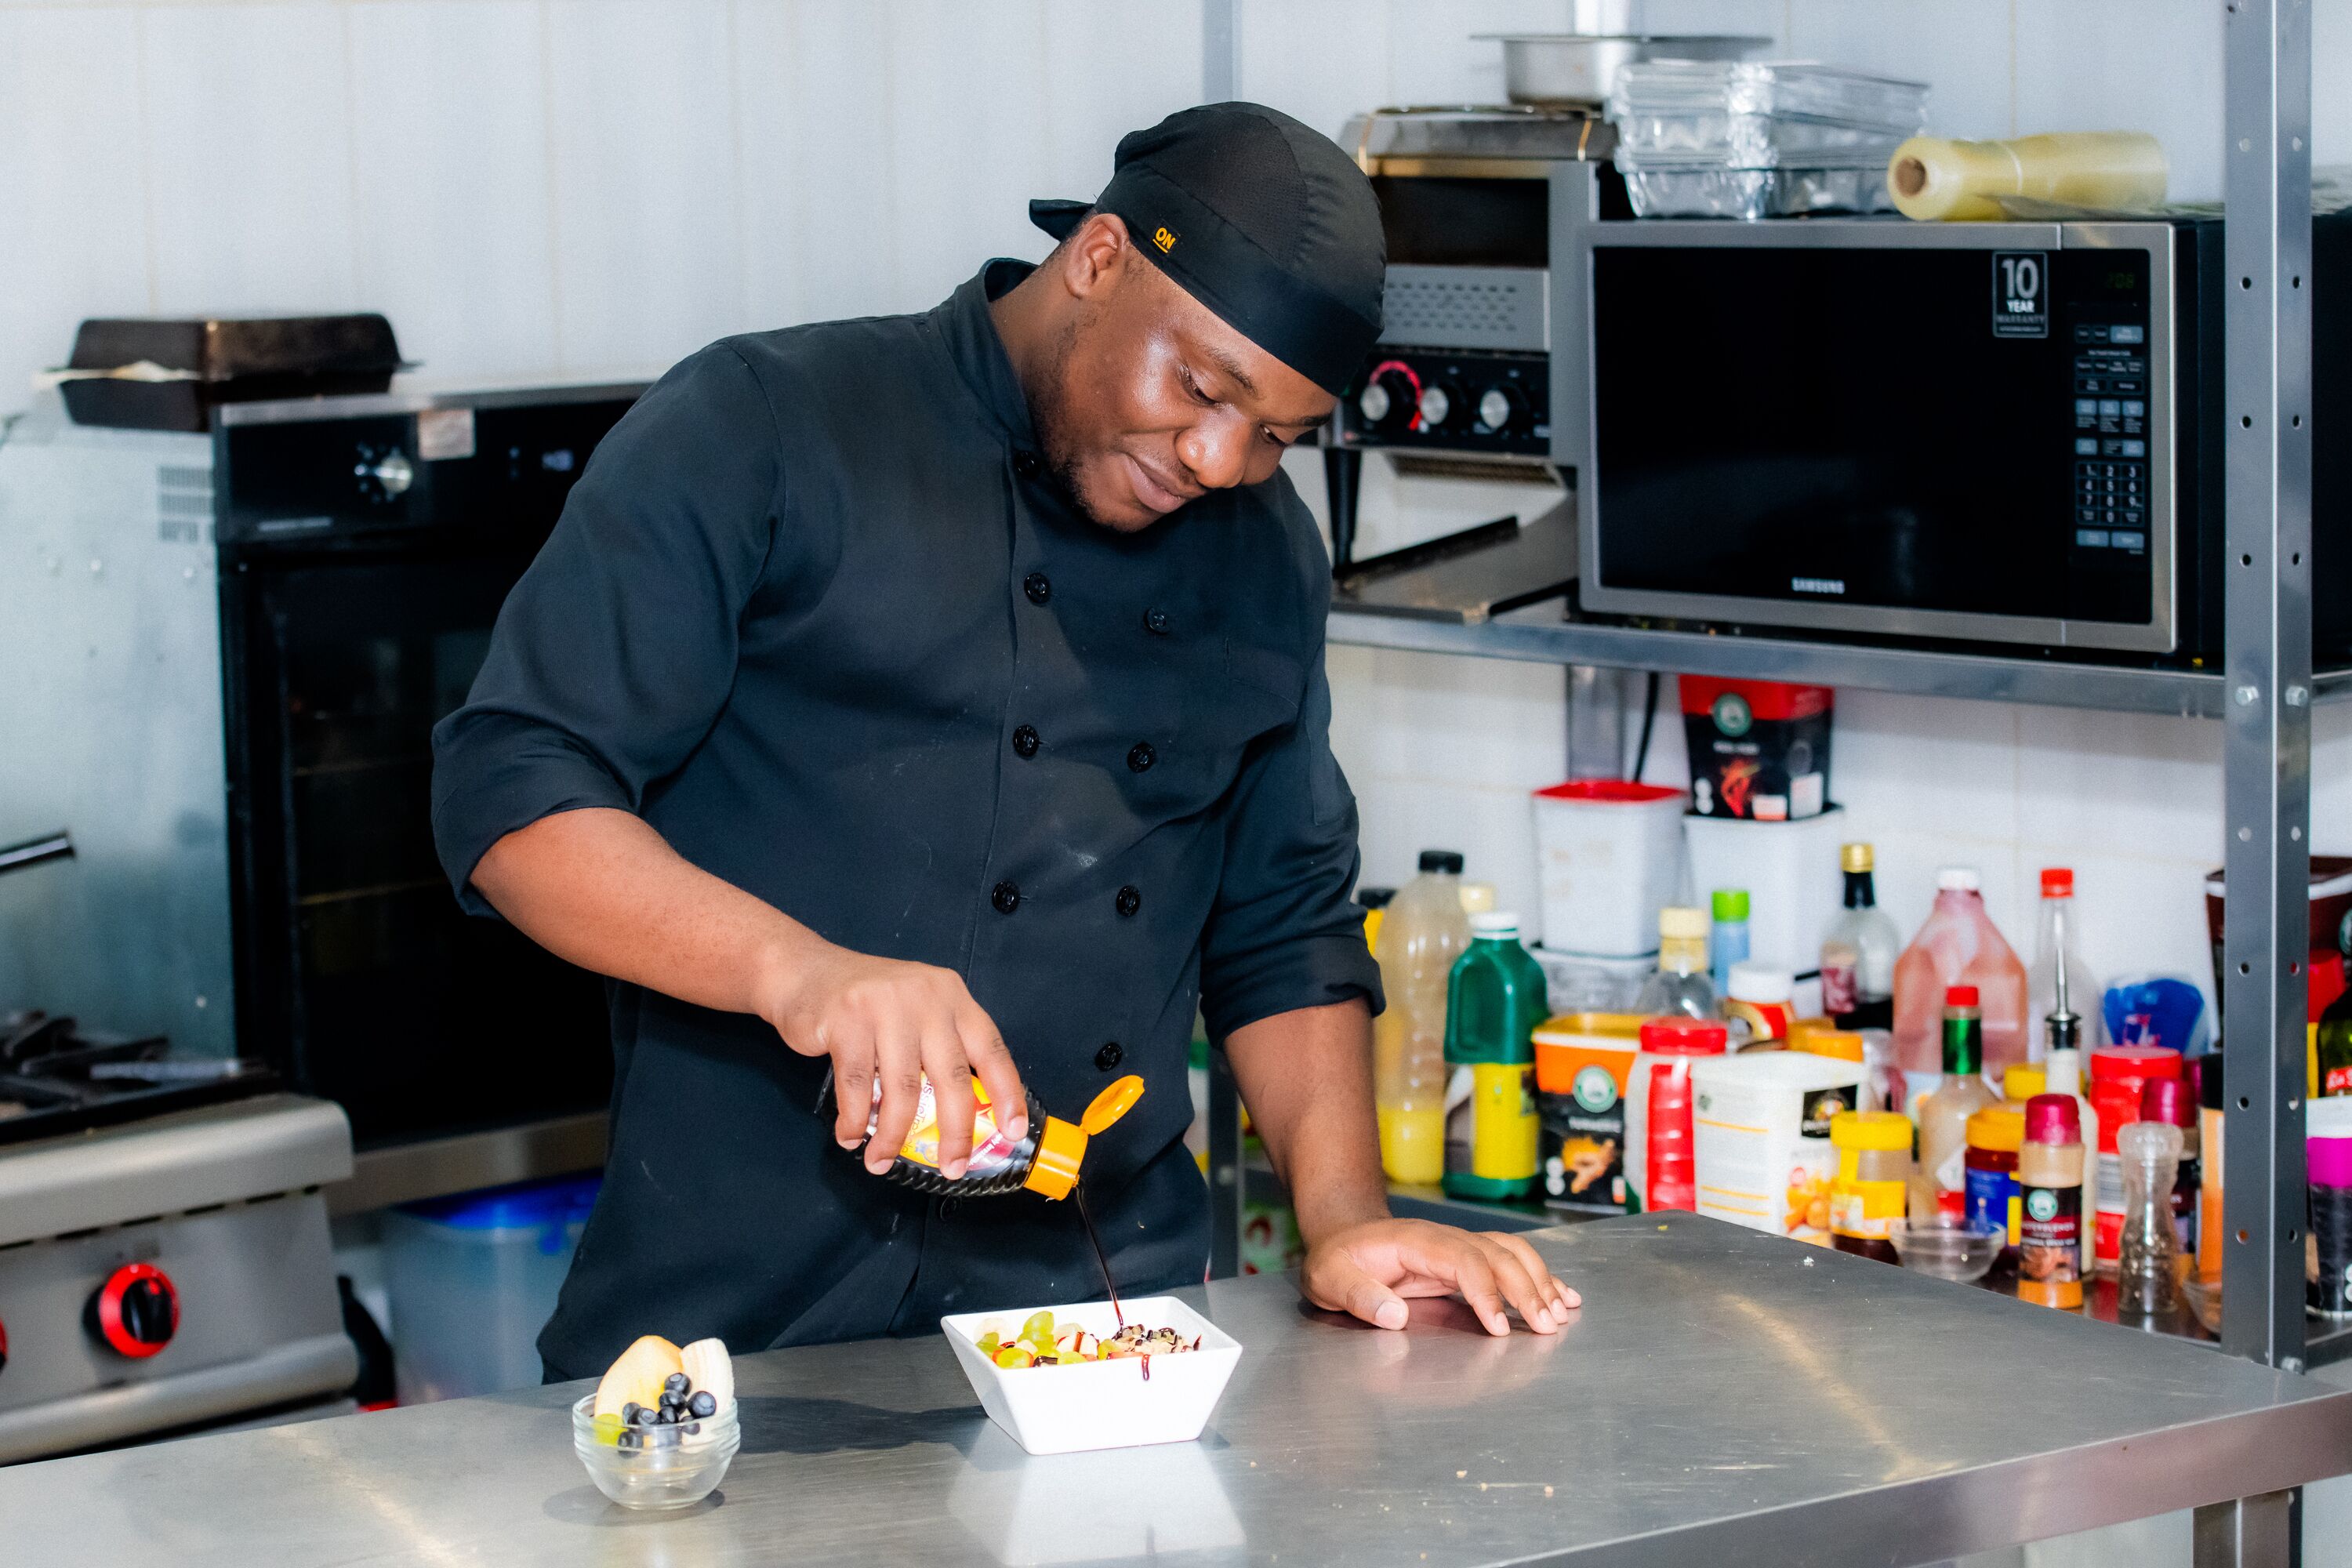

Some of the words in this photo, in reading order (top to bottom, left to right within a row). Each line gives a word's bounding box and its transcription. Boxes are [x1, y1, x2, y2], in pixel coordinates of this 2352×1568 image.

[1156, 227, 1176, 249] ON
[2002, 257, 2039, 299] 10
[2006, 299, 2035, 313] YEAR
